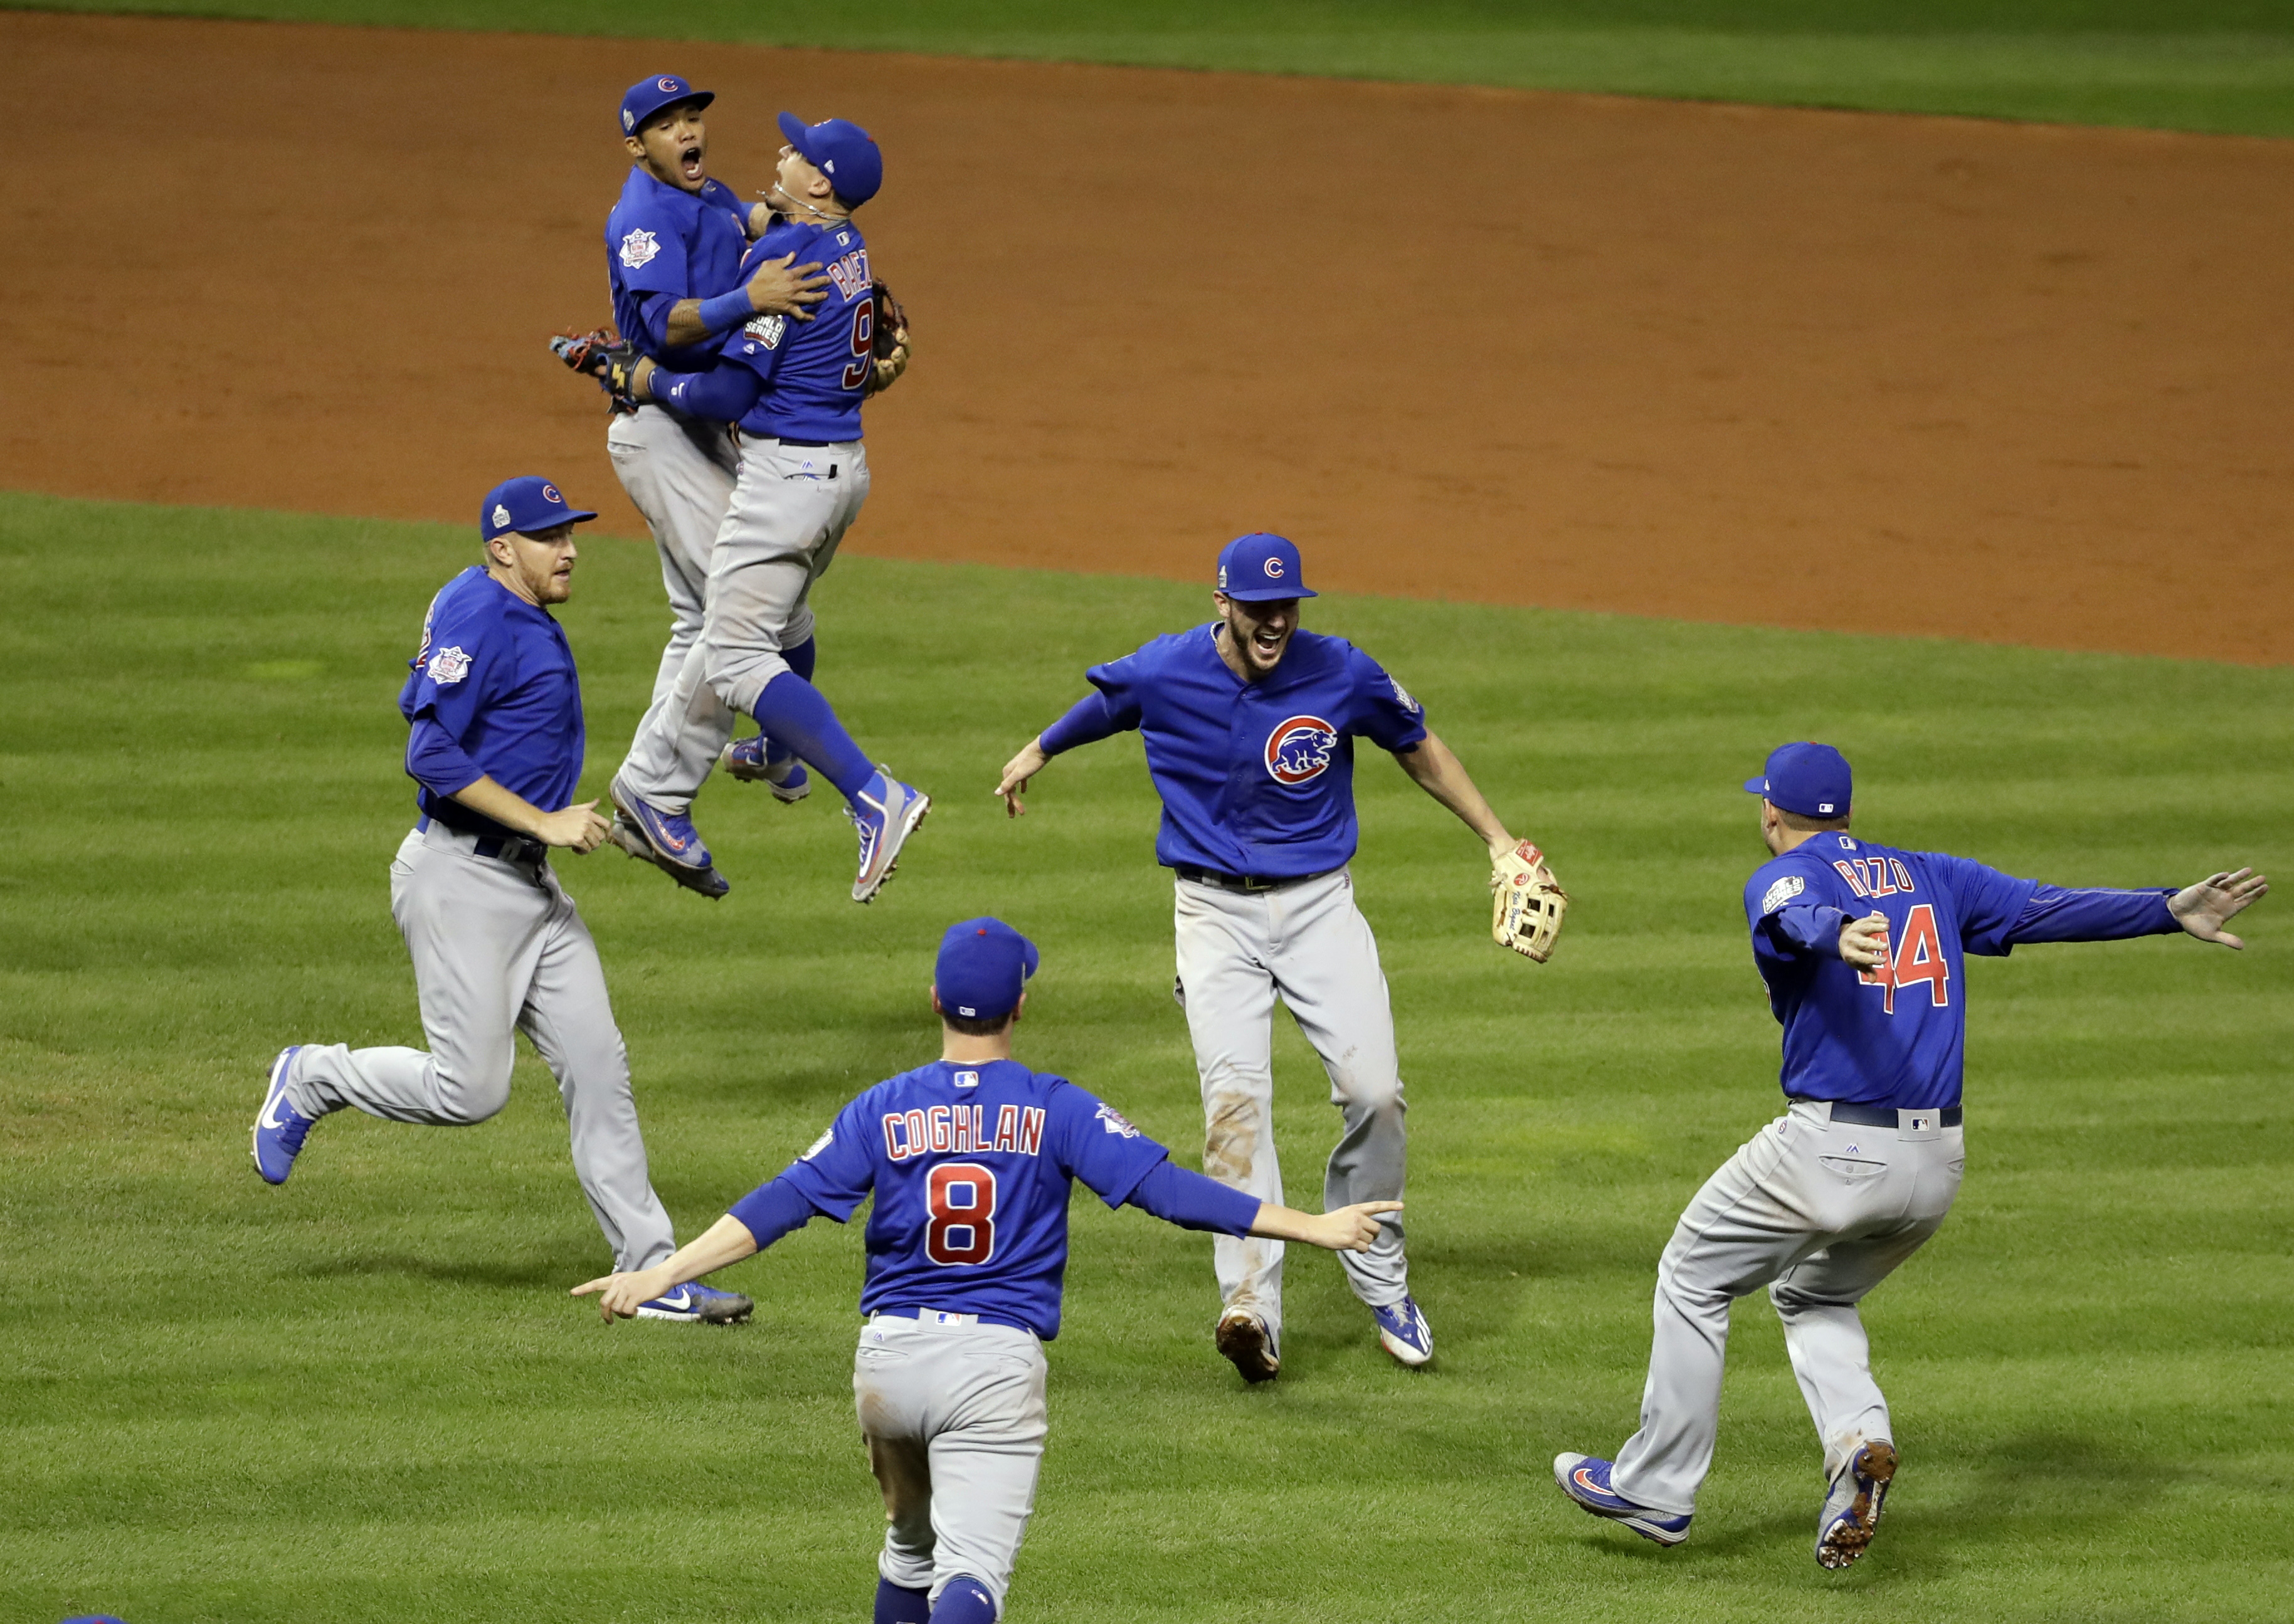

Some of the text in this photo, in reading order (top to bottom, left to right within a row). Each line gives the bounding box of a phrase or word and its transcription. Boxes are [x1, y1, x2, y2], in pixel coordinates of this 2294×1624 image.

[658, 77, 679, 93] C
[827, 250, 872, 302] BAEZ
[745, 321, 779, 344] SERIES
[754, 315, 784, 334] ORLD
[842, 297, 874, 390] 9
[542, 485, 563, 503] C
[1264, 557, 1284, 578] C
[1832, 857, 1915, 899] RZZO
[1765, 883, 1802, 911] SERIES
[883, 1104, 1045, 1161] COGHLAN
[925, 1163, 996, 1266] 8
